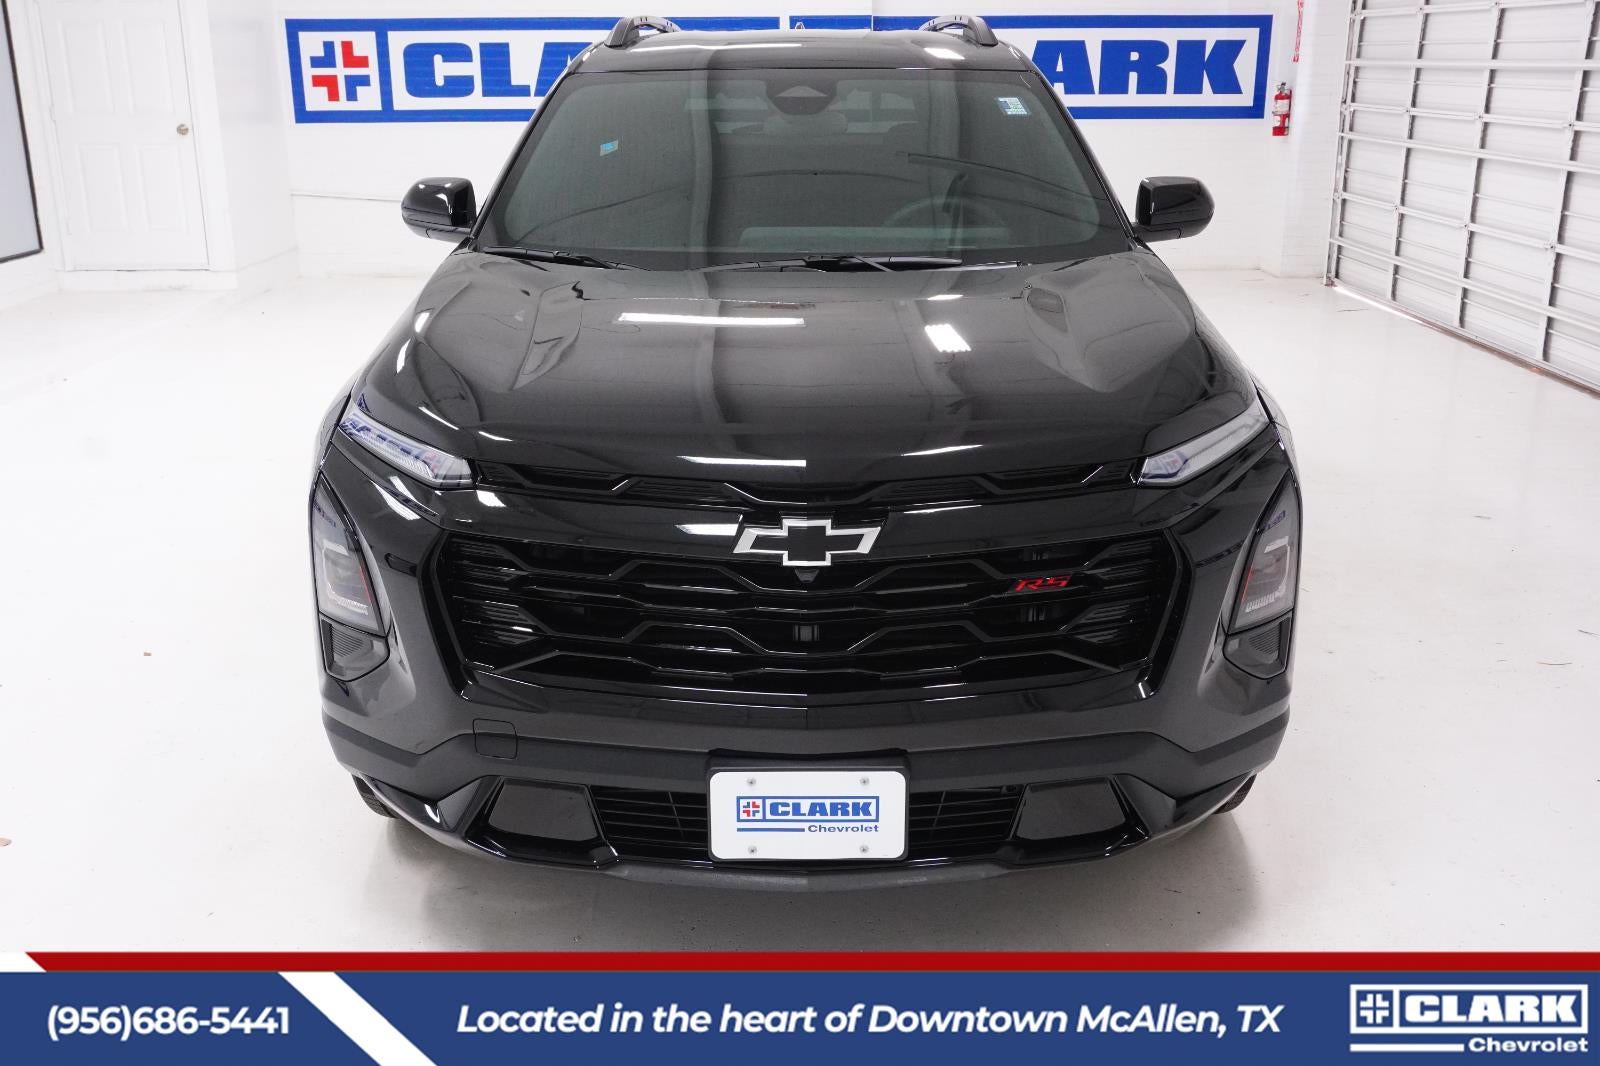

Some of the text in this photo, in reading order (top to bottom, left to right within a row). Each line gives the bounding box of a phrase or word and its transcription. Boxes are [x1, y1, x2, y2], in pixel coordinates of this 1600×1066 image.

[1014, 575, 1072, 592] RS
[769, 801, 873, 817] CLARK
[807, 824, 879, 833] Chevrolet
